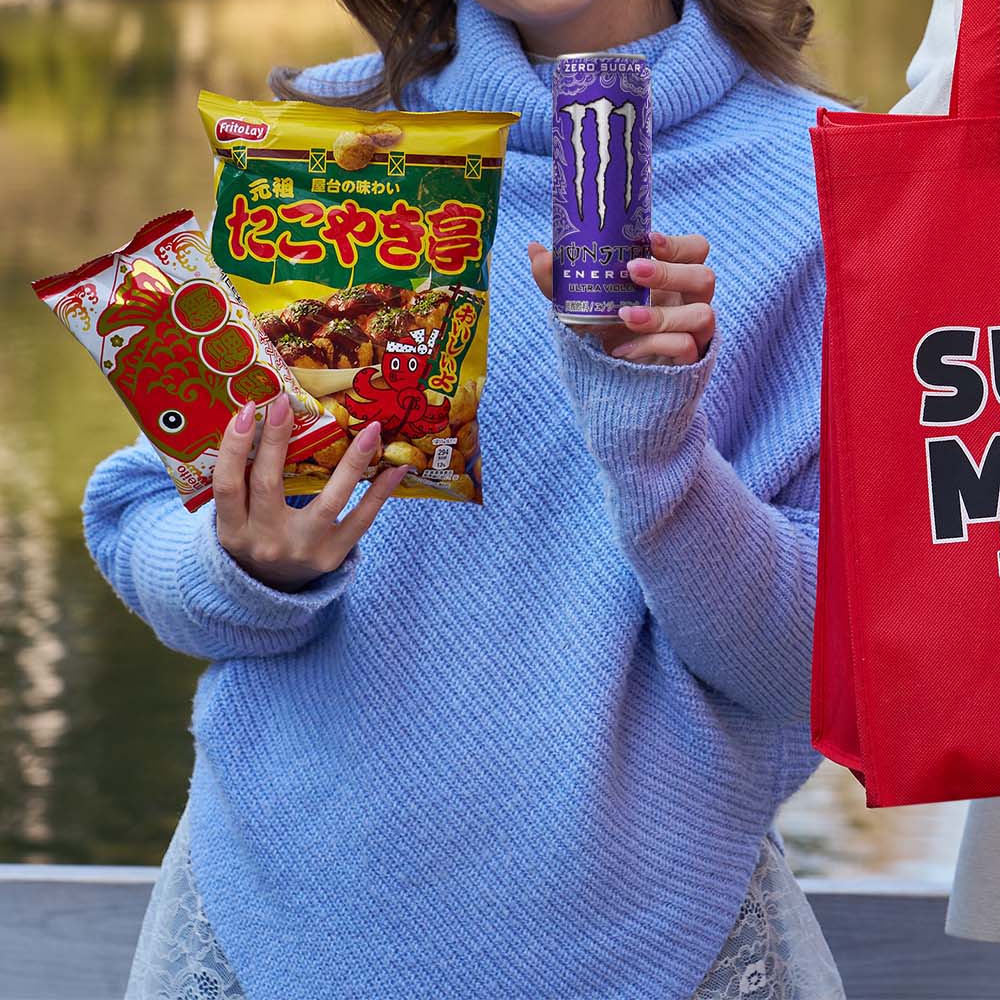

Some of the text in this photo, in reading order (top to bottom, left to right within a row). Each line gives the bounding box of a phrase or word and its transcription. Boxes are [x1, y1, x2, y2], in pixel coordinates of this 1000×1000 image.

[564, 63, 641, 72] ZERO SUGAR
[311, 178, 400, 195] 屋台の味わい
[225, 194, 485, 276] たこやき亭
[563, 269, 629, 279] ENERG
[568, 283, 602, 293] ULTRA
[428, 303, 477, 392] おいしいよ
[177, 465, 203, 489] meito
